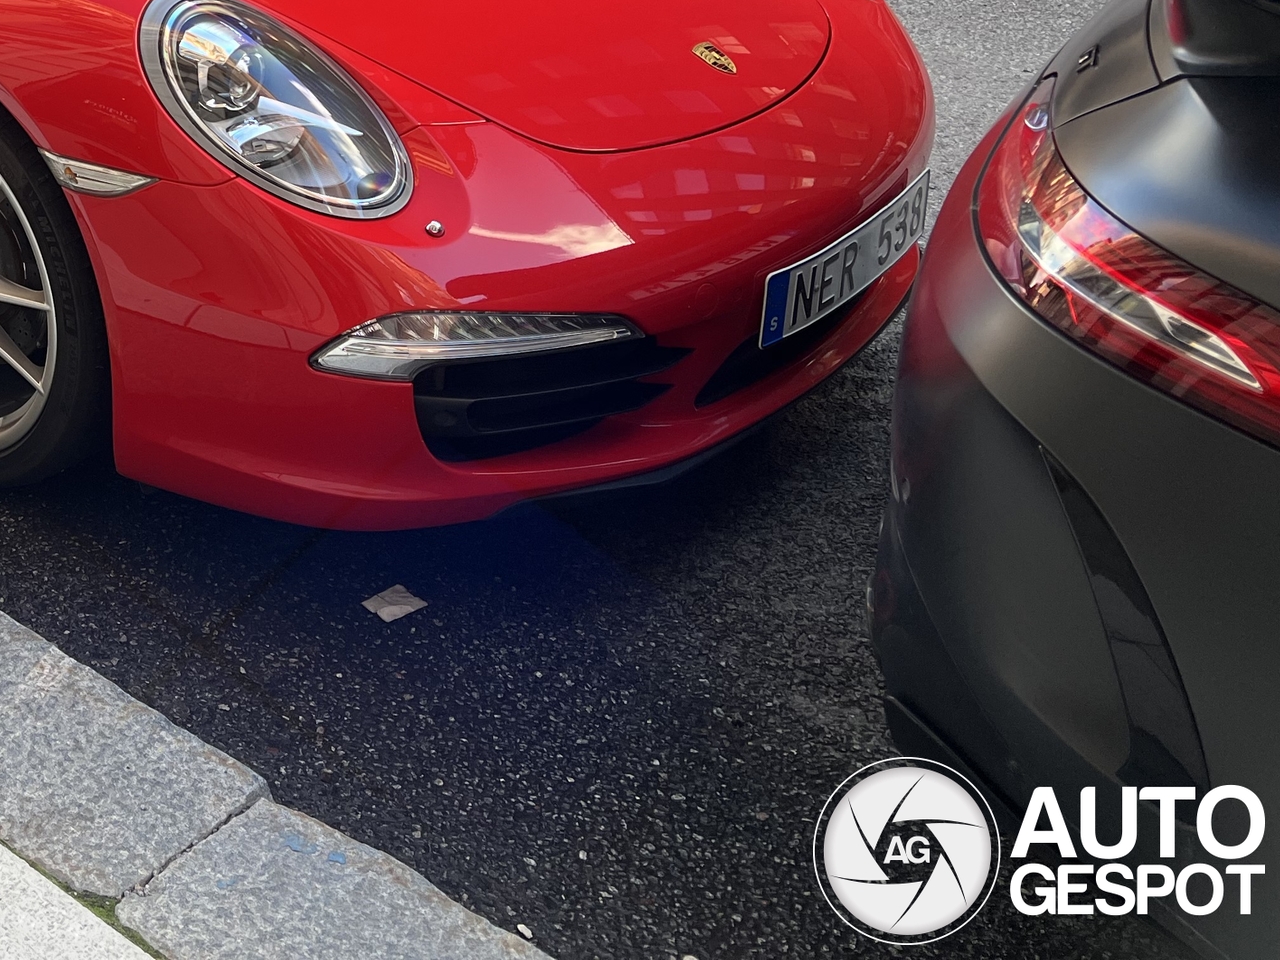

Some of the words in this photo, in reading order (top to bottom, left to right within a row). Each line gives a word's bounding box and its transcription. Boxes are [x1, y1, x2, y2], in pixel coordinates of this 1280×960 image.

[37, 215, 78, 336] MICHELIN
[789, 241, 859, 330] NER
[877, 186, 924, 266] 538
[769, 316, 778, 331] S
